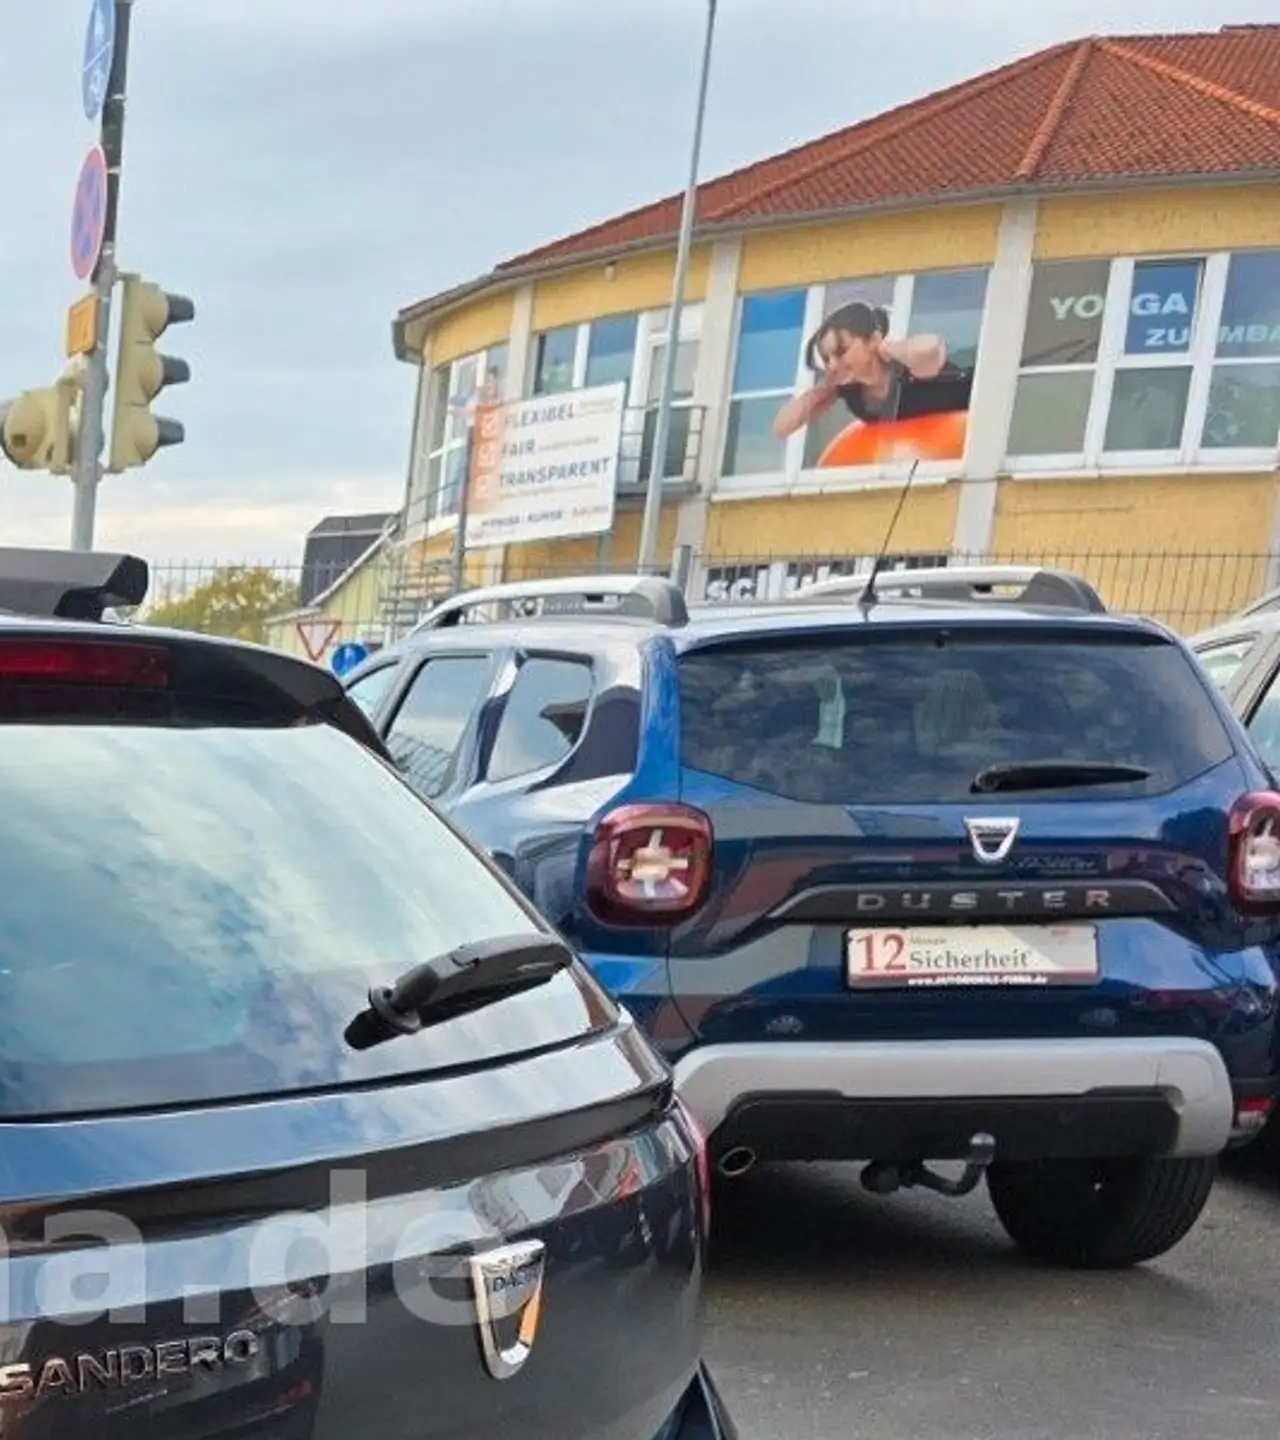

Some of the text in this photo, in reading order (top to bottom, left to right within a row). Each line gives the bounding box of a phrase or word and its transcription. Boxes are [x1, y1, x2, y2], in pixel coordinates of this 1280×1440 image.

[1049, 291, 1189, 320] YOGA
[501, 439, 536, 459] FAIR
[500, 457, 611, 487] TRANSPARENT
[857, 889, 1112, 911] DUSTER
[856, 932, 907, 972] 12
[908, 947, 1032, 970] Sicherheit
